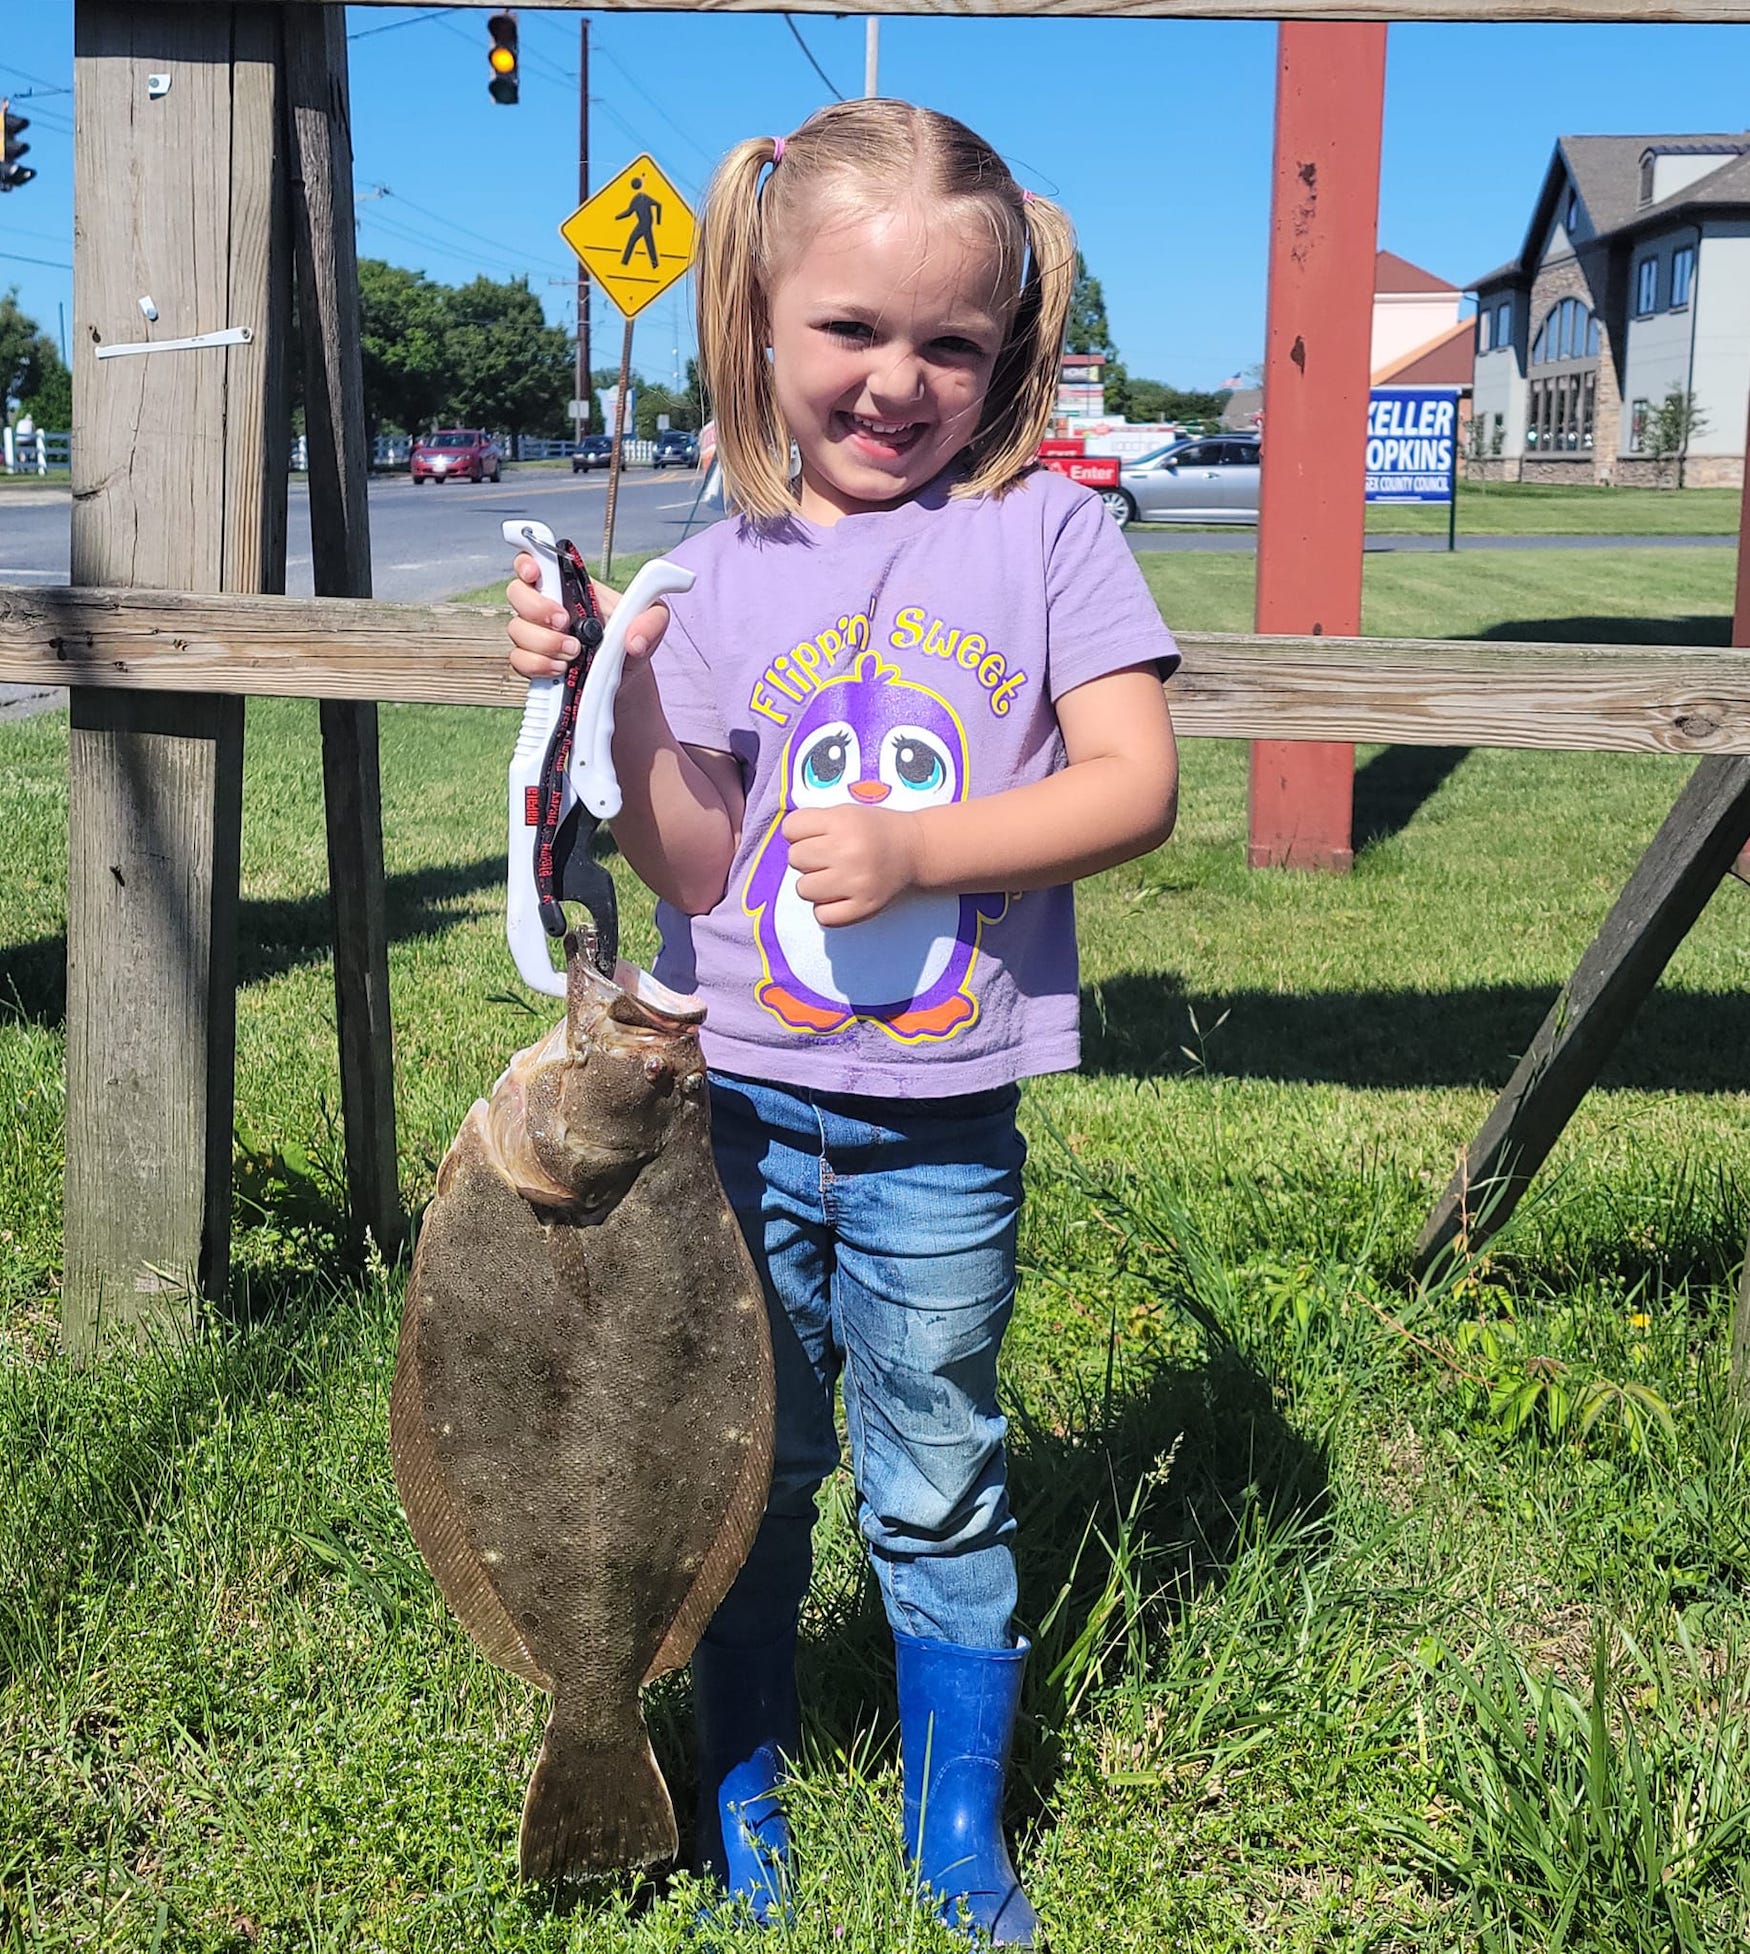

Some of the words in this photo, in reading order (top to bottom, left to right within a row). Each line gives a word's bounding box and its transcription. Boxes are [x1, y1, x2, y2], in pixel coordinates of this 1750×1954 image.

[1366, 439, 1452, 470] OPKINS
[1070, 465, 1115, 479] Enter
[1380, 476, 1413, 491] COUNTY
[1414, 476, 1450, 491] COUNCIL
[890, 606, 1028, 717] Sweet
